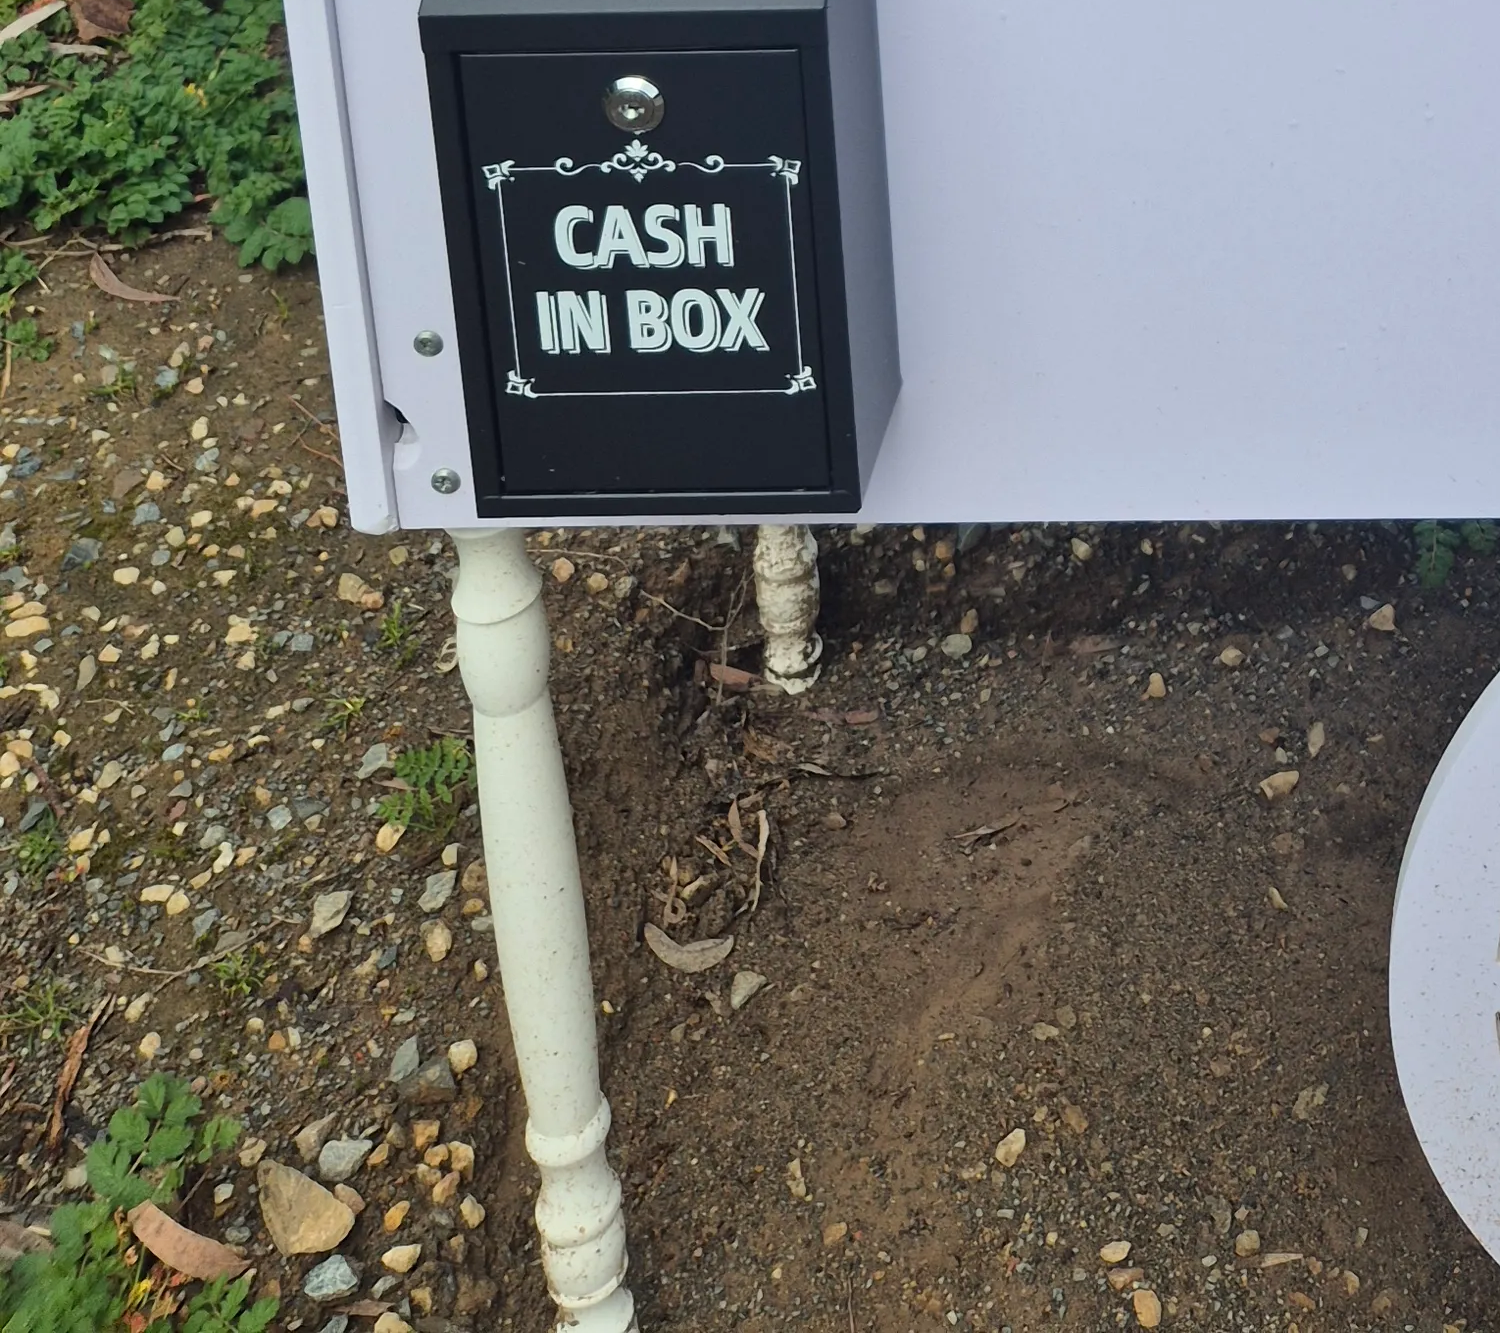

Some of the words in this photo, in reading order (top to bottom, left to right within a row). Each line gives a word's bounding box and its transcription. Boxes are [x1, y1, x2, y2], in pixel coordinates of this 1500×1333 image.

[552, 203, 736, 270] CASH
[535, 288, 612, 355] IN
[626, 286, 770, 353] BOX
